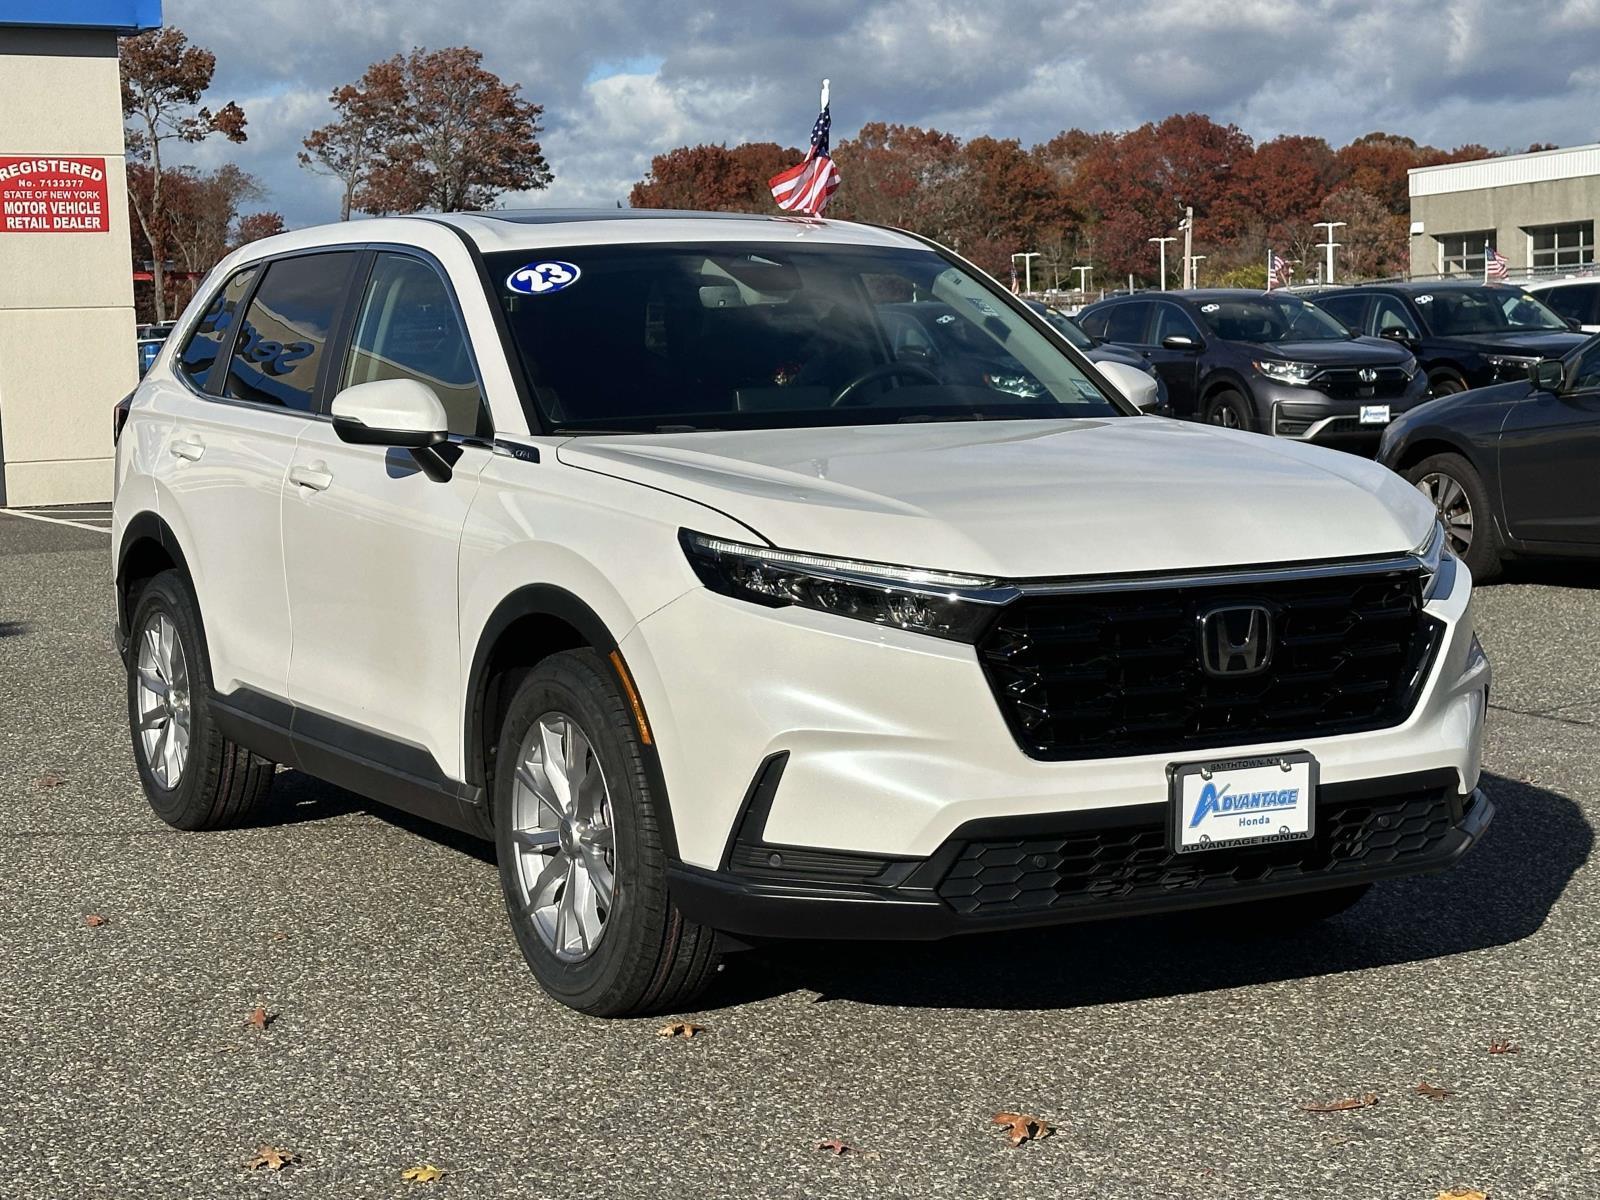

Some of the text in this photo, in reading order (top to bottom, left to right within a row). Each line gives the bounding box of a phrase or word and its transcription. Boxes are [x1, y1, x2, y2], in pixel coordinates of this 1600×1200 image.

[0, 160, 103, 181] REGISTERED
[40, 179, 84, 187] 7133377
[4, 191, 100, 199] STATE OF NEW YORK
[4, 202, 101, 215] MOTOR VEHICLE
[6, 217, 101, 229] RETAIL DEALER
[516, 263, 572, 292] 23
[1189, 782, 1299, 828] ADVANTAGE
[1239, 816, 1270, 827] Honda
[1182, 831, 1308, 853] ADVANTAGE HONDA
